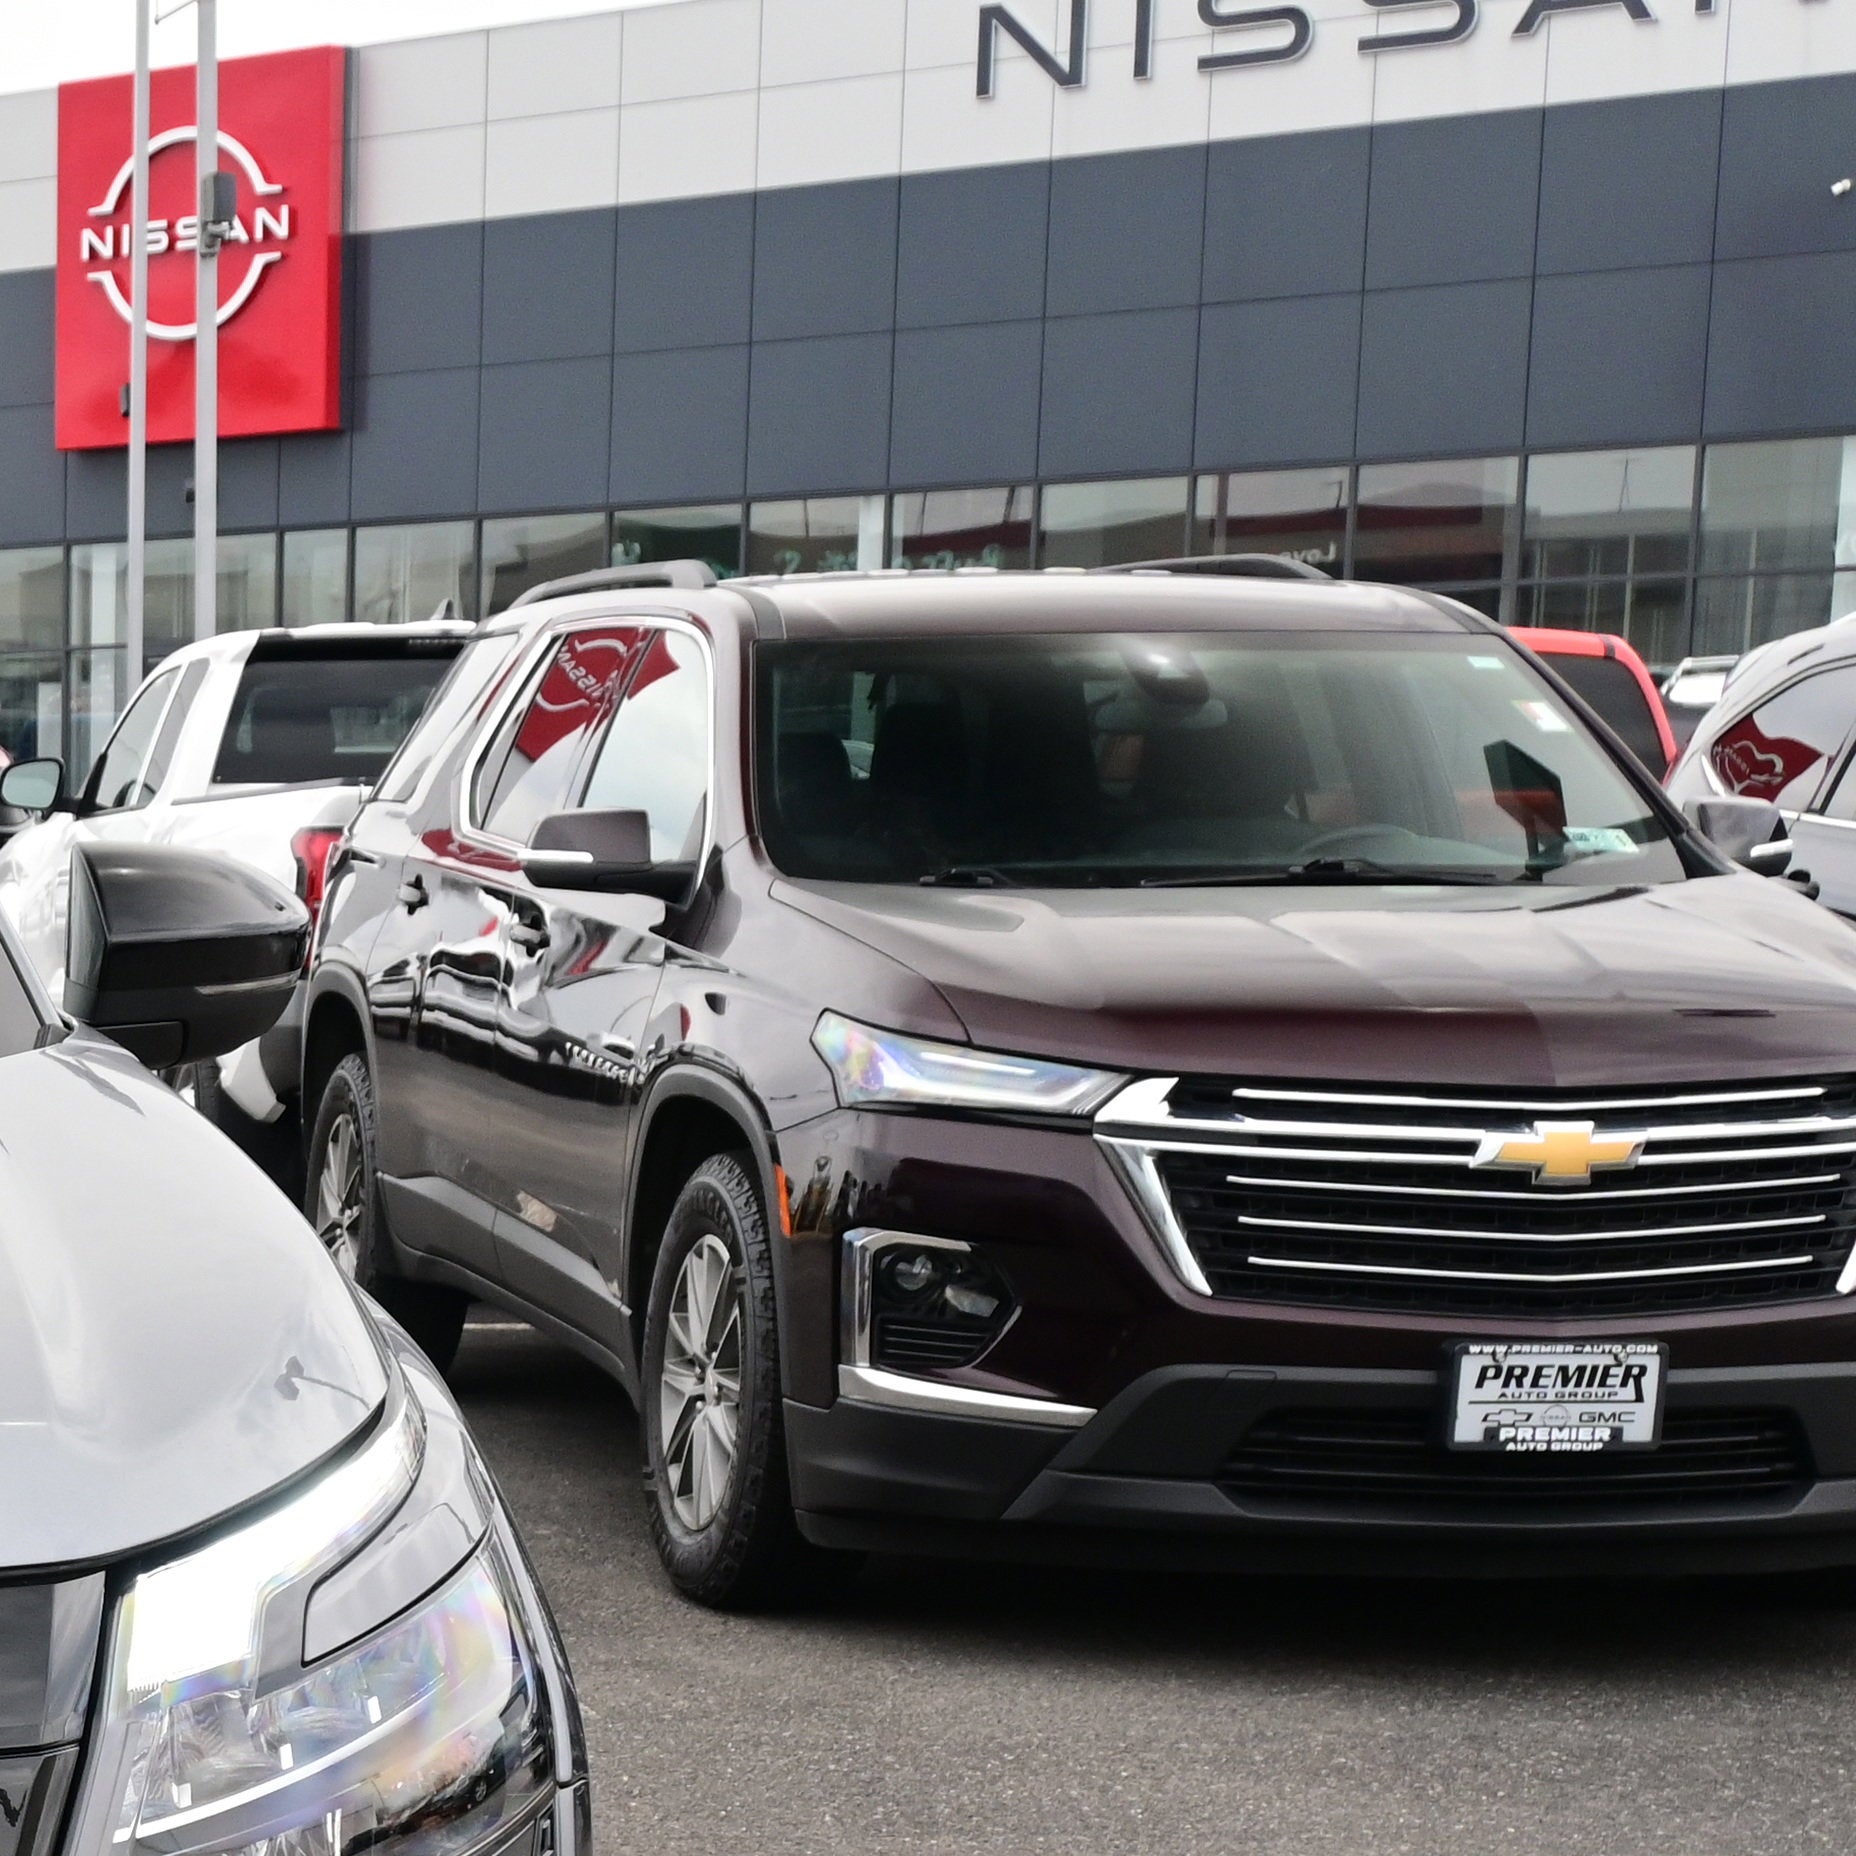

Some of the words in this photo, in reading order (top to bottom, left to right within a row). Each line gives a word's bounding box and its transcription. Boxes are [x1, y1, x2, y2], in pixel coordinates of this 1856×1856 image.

[1468, 1344, 1658, 1354] WWW.PREMIER-AUTO.COM
[1475, 1364, 1647, 1402] PREMIER
[1498, 1391, 1547, 1399] AUTO
[1554, 1391, 1619, 1399] GROUP
[1578, 1412, 1636, 1423] GMC
[1499, 1427, 1611, 1441] PREMIER
[1505, 1442, 1547, 1451] AUTO
[1551, 1442, 1604, 1451] GROUP
